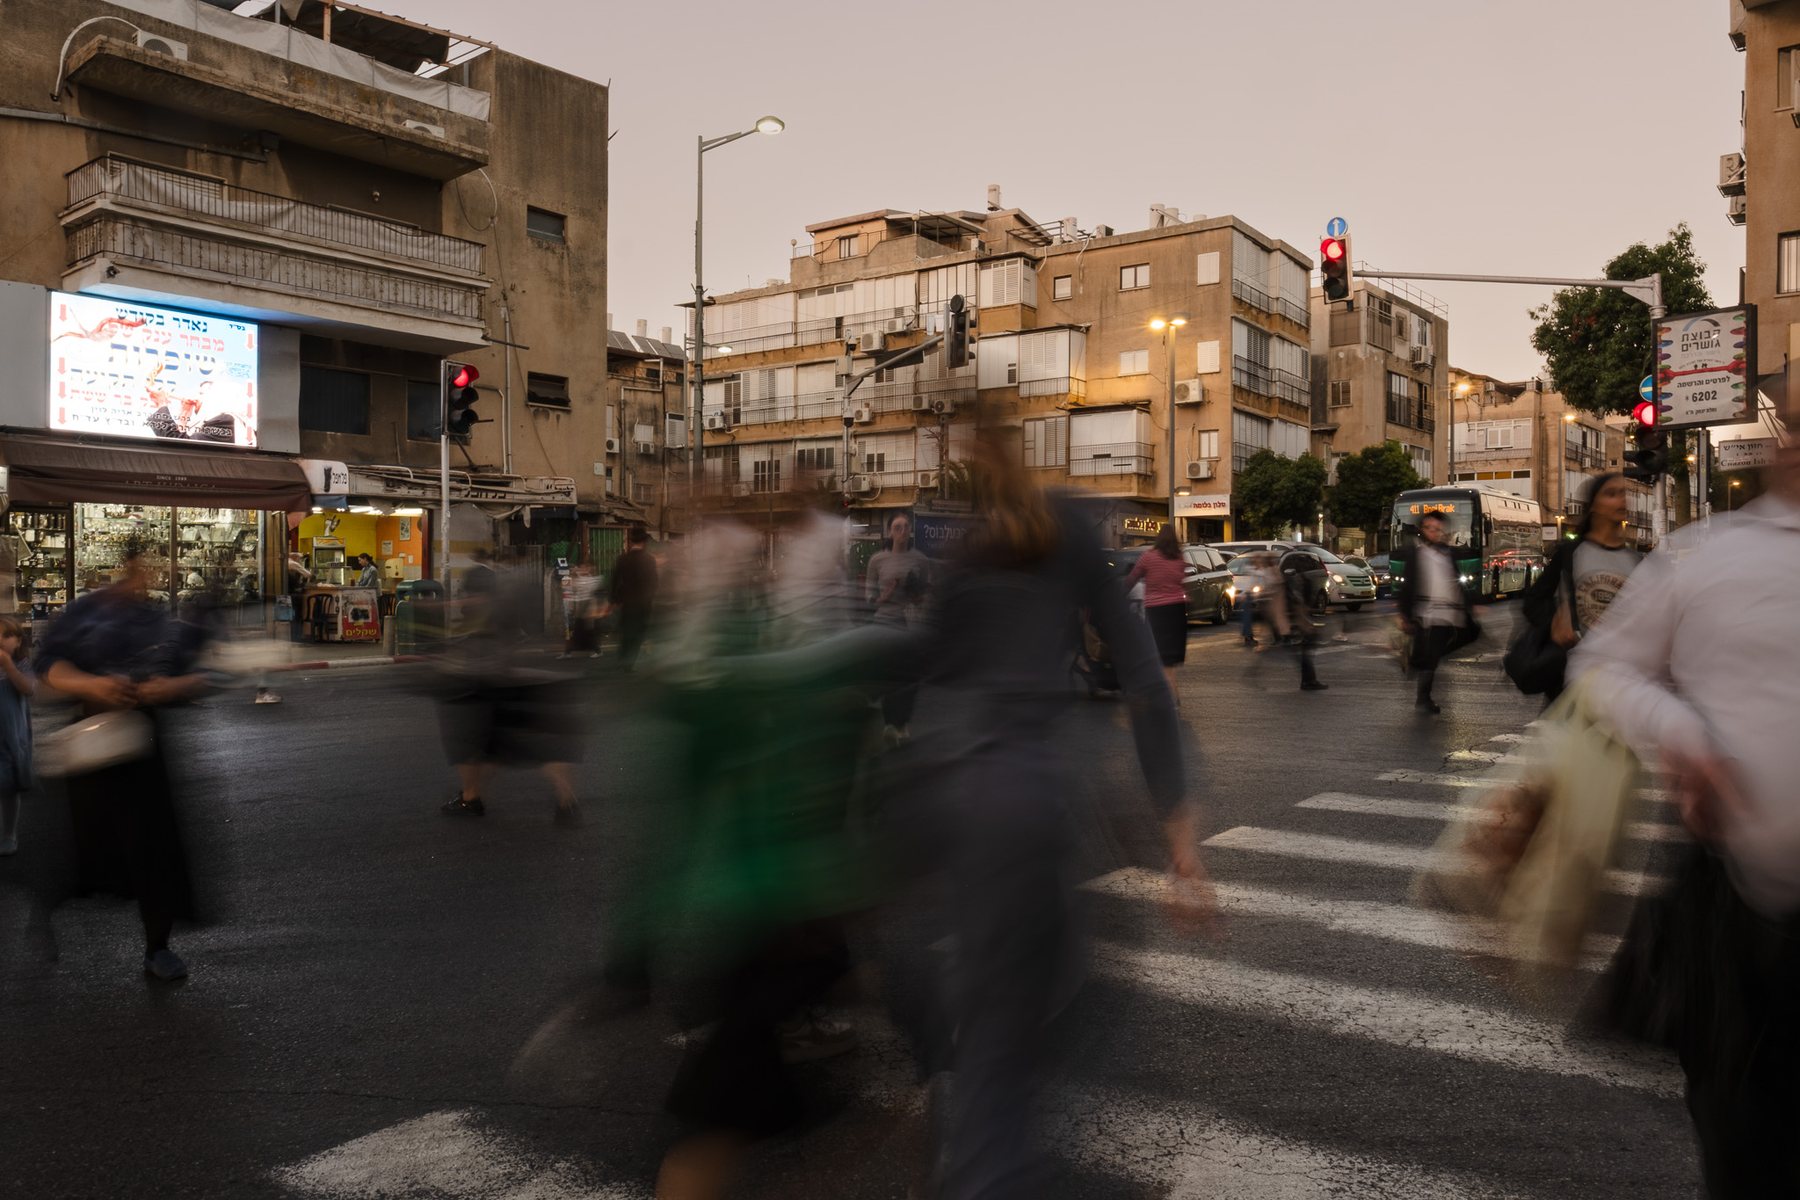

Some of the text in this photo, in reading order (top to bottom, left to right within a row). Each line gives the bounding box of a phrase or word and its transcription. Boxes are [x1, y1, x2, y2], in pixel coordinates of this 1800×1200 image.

[115, 307, 208, 333] נאדר בקודש
[179, 333, 225, 352] מבחר
[1681, 329, 1721, 343] קבוצת
[1676, 375, 1731, 388] לפרטים והרשמה
[1691, 390, 1718, 402] 6202
[345, 628, 377, 637] שקלים
